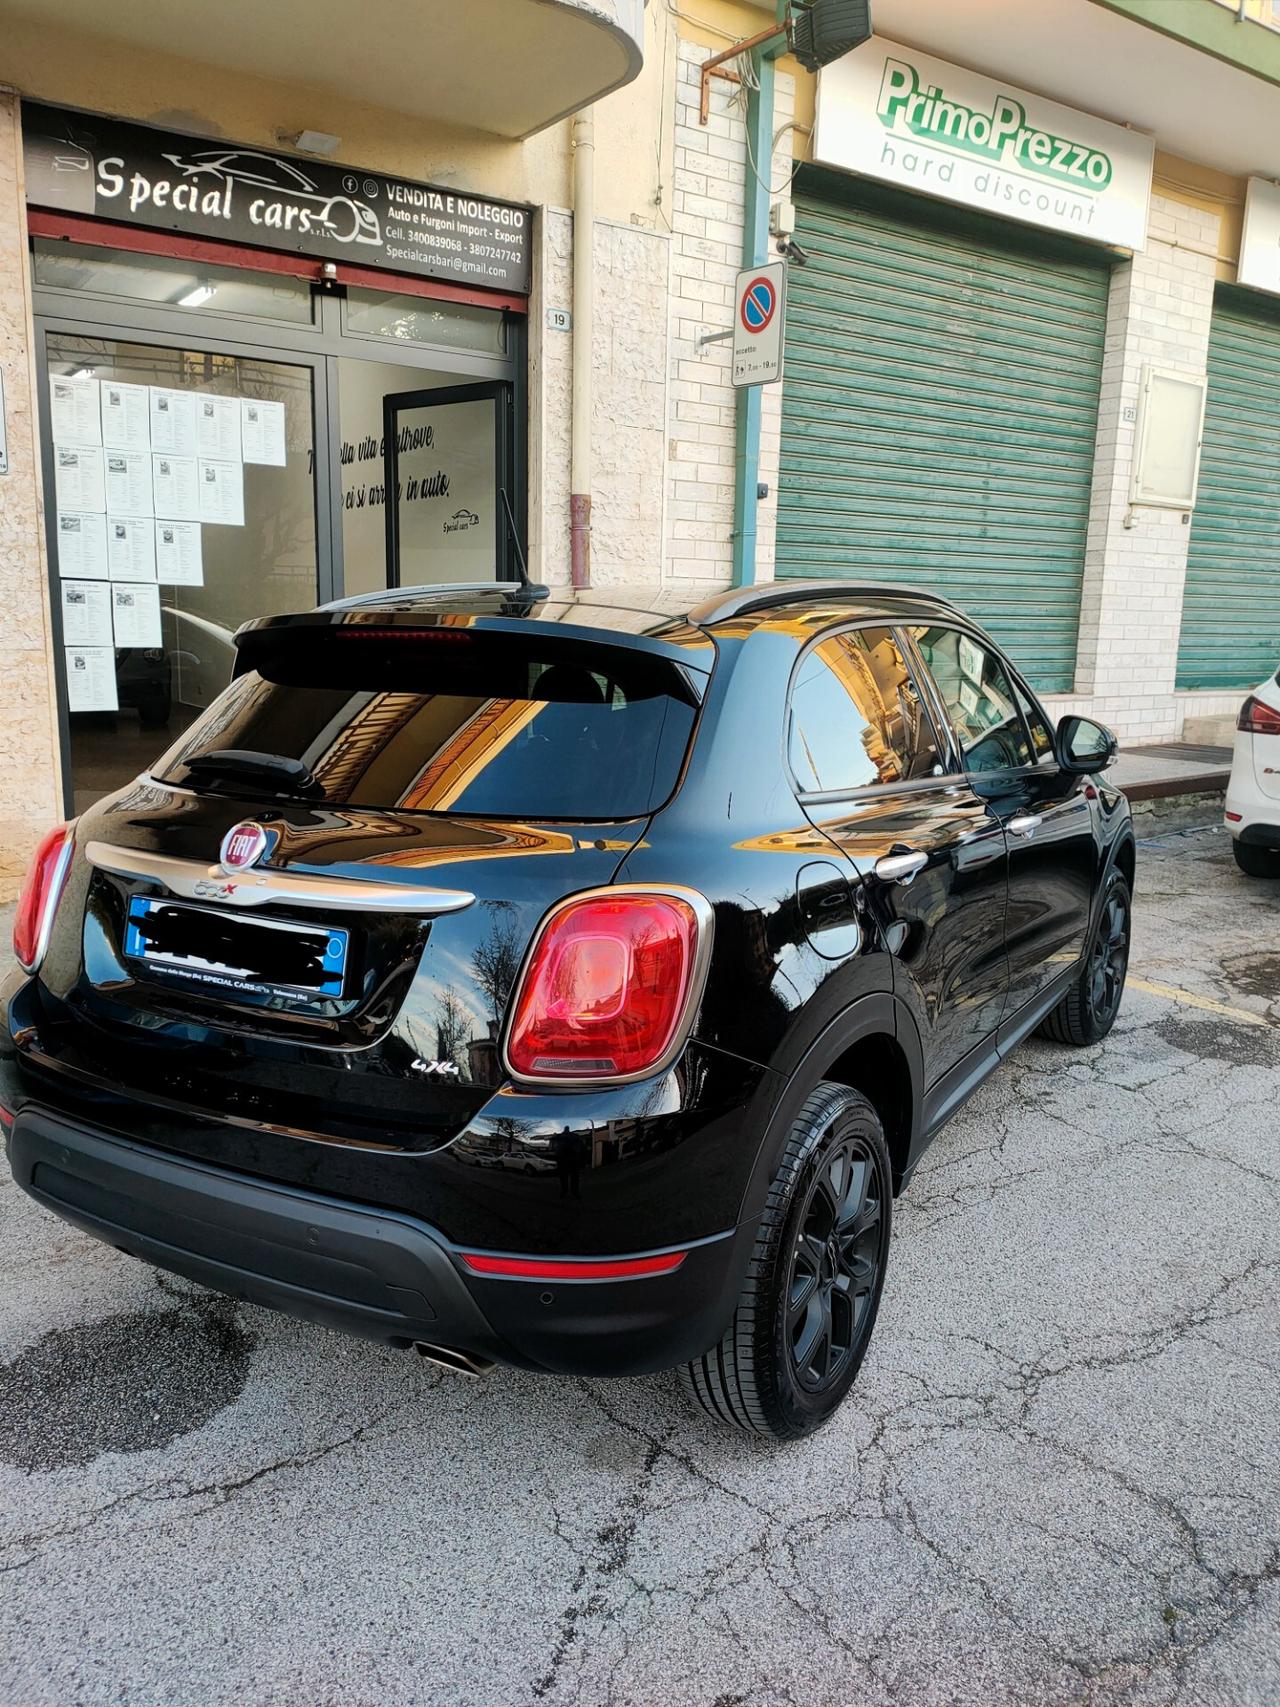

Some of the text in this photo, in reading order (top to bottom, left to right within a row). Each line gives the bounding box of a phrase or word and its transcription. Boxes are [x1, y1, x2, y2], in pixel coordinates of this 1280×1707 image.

[876, 56, 1113, 192] PrimoPrezzo
[96, 157, 312, 233] Special cars
[881, 142, 1096, 225] hard discount
[387, 184, 524, 228] VENDITA E NOLEGGIO
[387, 206, 411, 222] Auto
[412, 214, 419, 223] e
[420, 213, 456, 231] Furgoni
[456, 221, 488, 238] Import
[494, 228, 523, 245] Export
[385, 225, 406, 241] Cell.
[407, 229, 462, 251] 3400839068
[469, 242, 522, 264] 3807247742
[386, 244, 507, 278] Specialcarsbari@gmail.com
[554, 313, 565, 326] 19
[358, 435, 378, 462] vita
[227, 834, 257, 857] FIAT
[203, 975, 233, 986] SPECIAL
[234, 981, 255, 990] CARS
